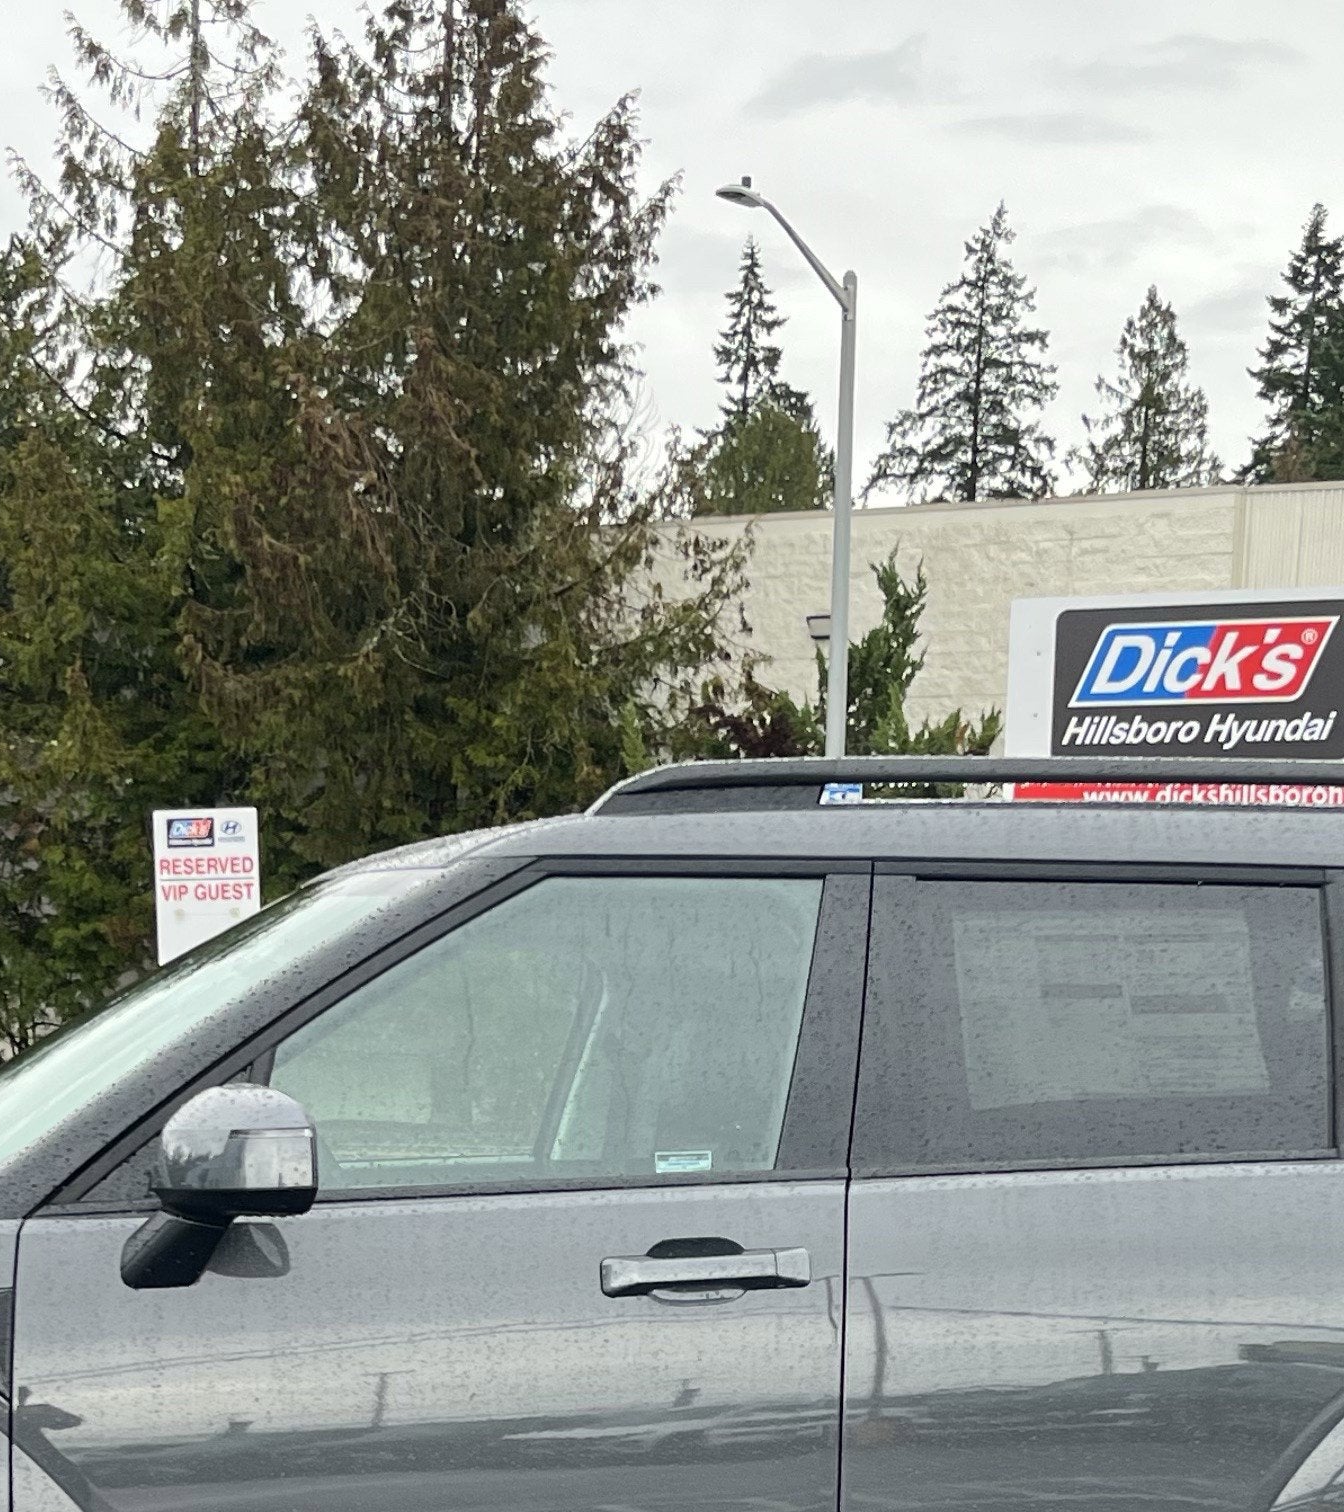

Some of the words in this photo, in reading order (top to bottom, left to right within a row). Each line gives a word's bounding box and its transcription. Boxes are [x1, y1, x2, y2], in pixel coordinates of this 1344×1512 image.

[1061, 713, 1200, 746] Hillsboro
[1205, 711, 1337, 750] Hyundai
[159, 857, 254, 875] RESERVED
[161, 885, 189, 901] VIP
[194, 883, 254, 901] GUEST
